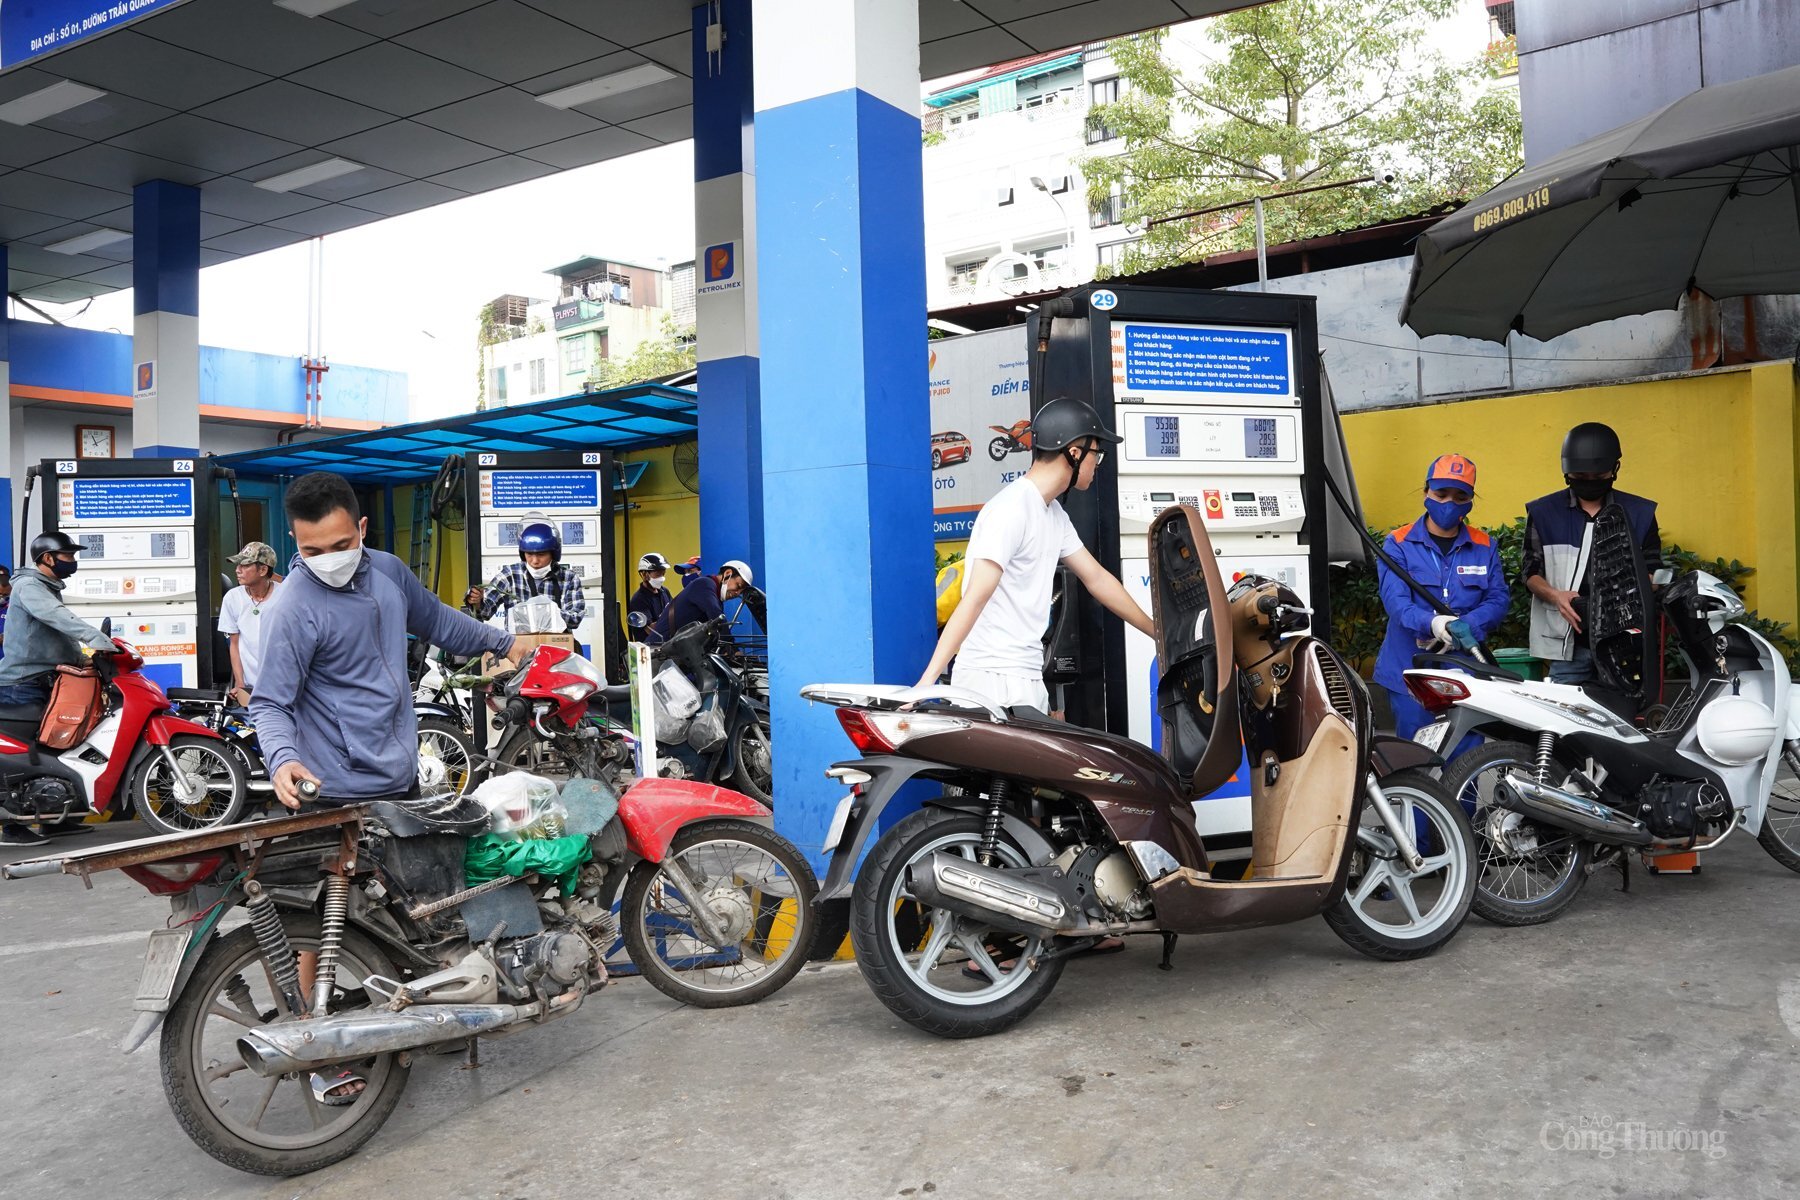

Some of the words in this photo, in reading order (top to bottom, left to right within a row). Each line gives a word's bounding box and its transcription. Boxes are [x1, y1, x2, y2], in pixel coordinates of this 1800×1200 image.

[31, 40, 42, 51] ĐỊA
[44, 28, 55, 46] CHỈ
[60, 22, 70, 39] SỐ
[71, 23, 82, 34] 01,
[83, 12, 107, 30] ĐƯỜNG
[130, 0, 155, 11] QUAN
[1474, 188, 1549, 232] 0969.809.419
[698, 281, 741, 294] PETROLIMEX
[1094, 294, 1114, 306] 29
[1022, 380, 1030, 392] B
[1156, 417, 1178, 430] 95368
[1254, 420, 1275, 432] 68073
[1160, 446, 1179, 455] 23860
[482, 455, 494, 464] 27
[586, 454, 598, 463] 28
[60, 463, 74, 471] 25
[177, 462, 190, 470] 26
[1002, 473, 1014, 483] XE
[934, 522, 952, 532] ÔNG
[955, 522, 965, 531] TY
[1073, 767, 1124, 782] SH
